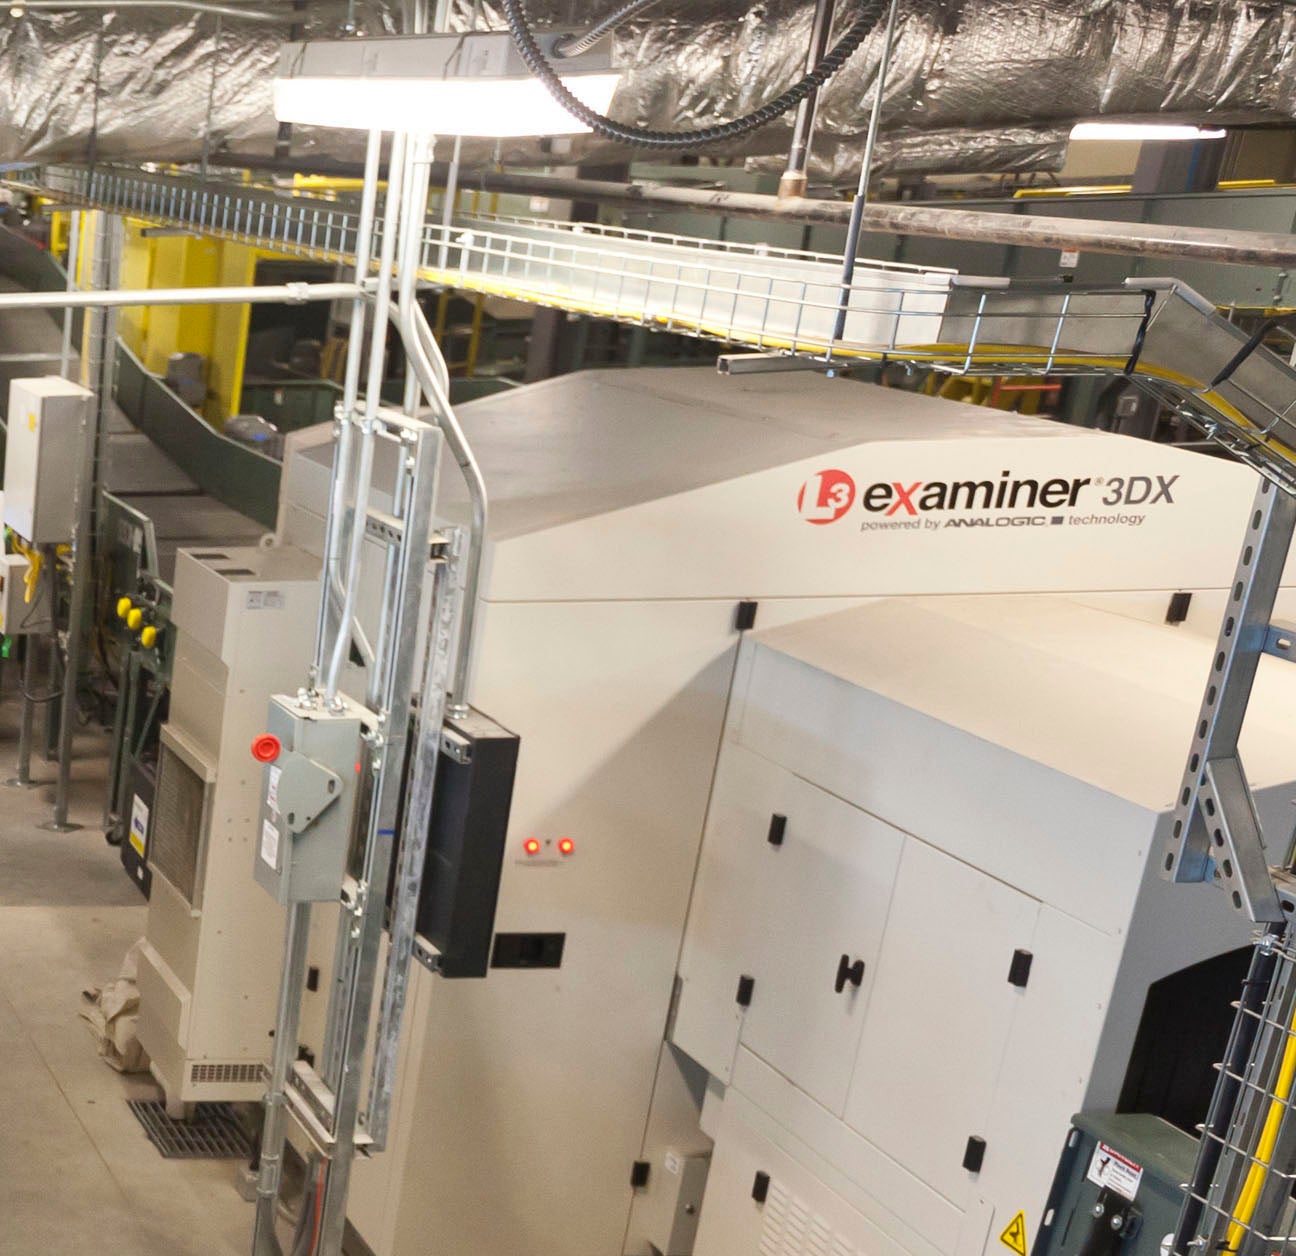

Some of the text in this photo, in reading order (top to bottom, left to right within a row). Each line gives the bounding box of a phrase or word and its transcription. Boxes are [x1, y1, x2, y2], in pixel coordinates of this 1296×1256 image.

[801, 472, 853, 523] L3
[1102, 475, 1180, 506] 3DX
[860, 513, 1145, 532] powered by ANALOGIC technology
